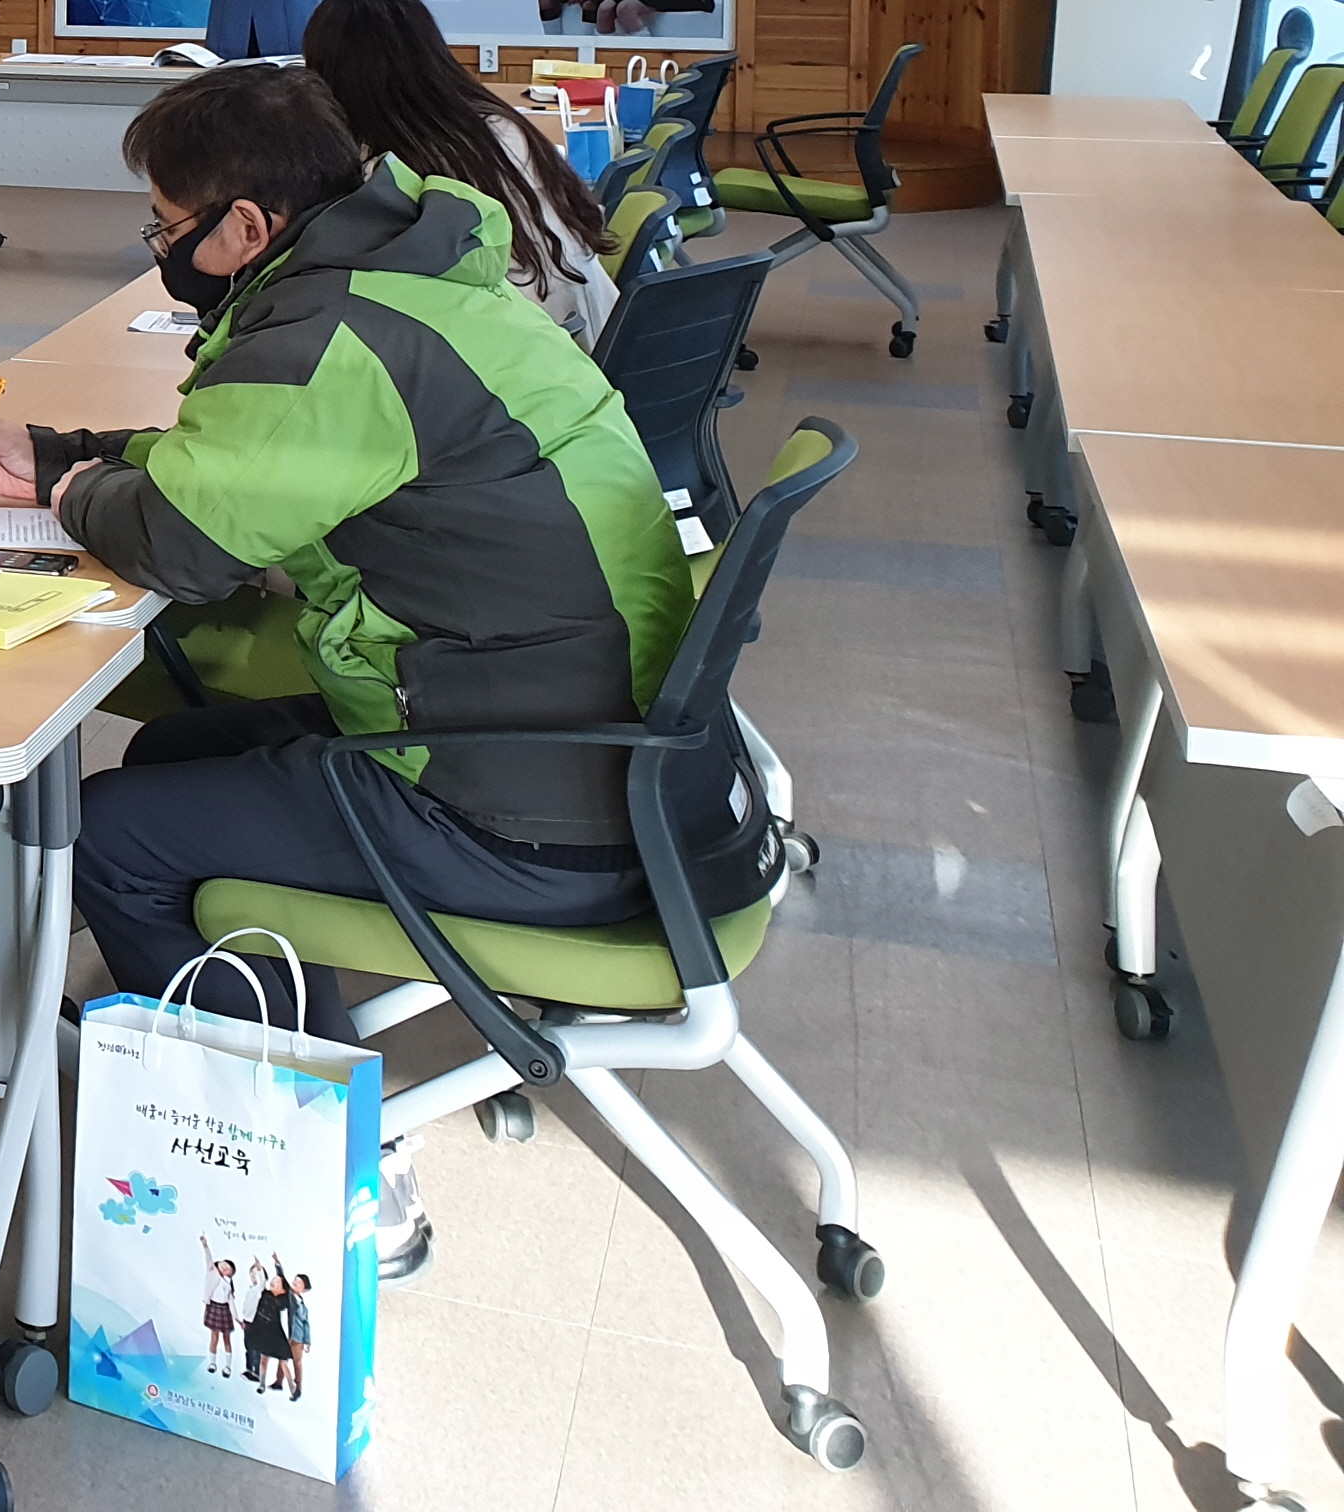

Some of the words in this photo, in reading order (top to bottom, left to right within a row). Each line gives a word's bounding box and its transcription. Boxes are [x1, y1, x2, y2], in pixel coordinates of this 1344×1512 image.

[136, 1104, 167, 1120] 배움이
[170, 1109, 201, 1130] 즐거운
[205, 1116, 224, 1134] 학교
[227, 1123, 253, 1143] 함께
[257, 1133, 287, 1151] 가꾸는
[170, 1137, 252, 1177] 사천교육
